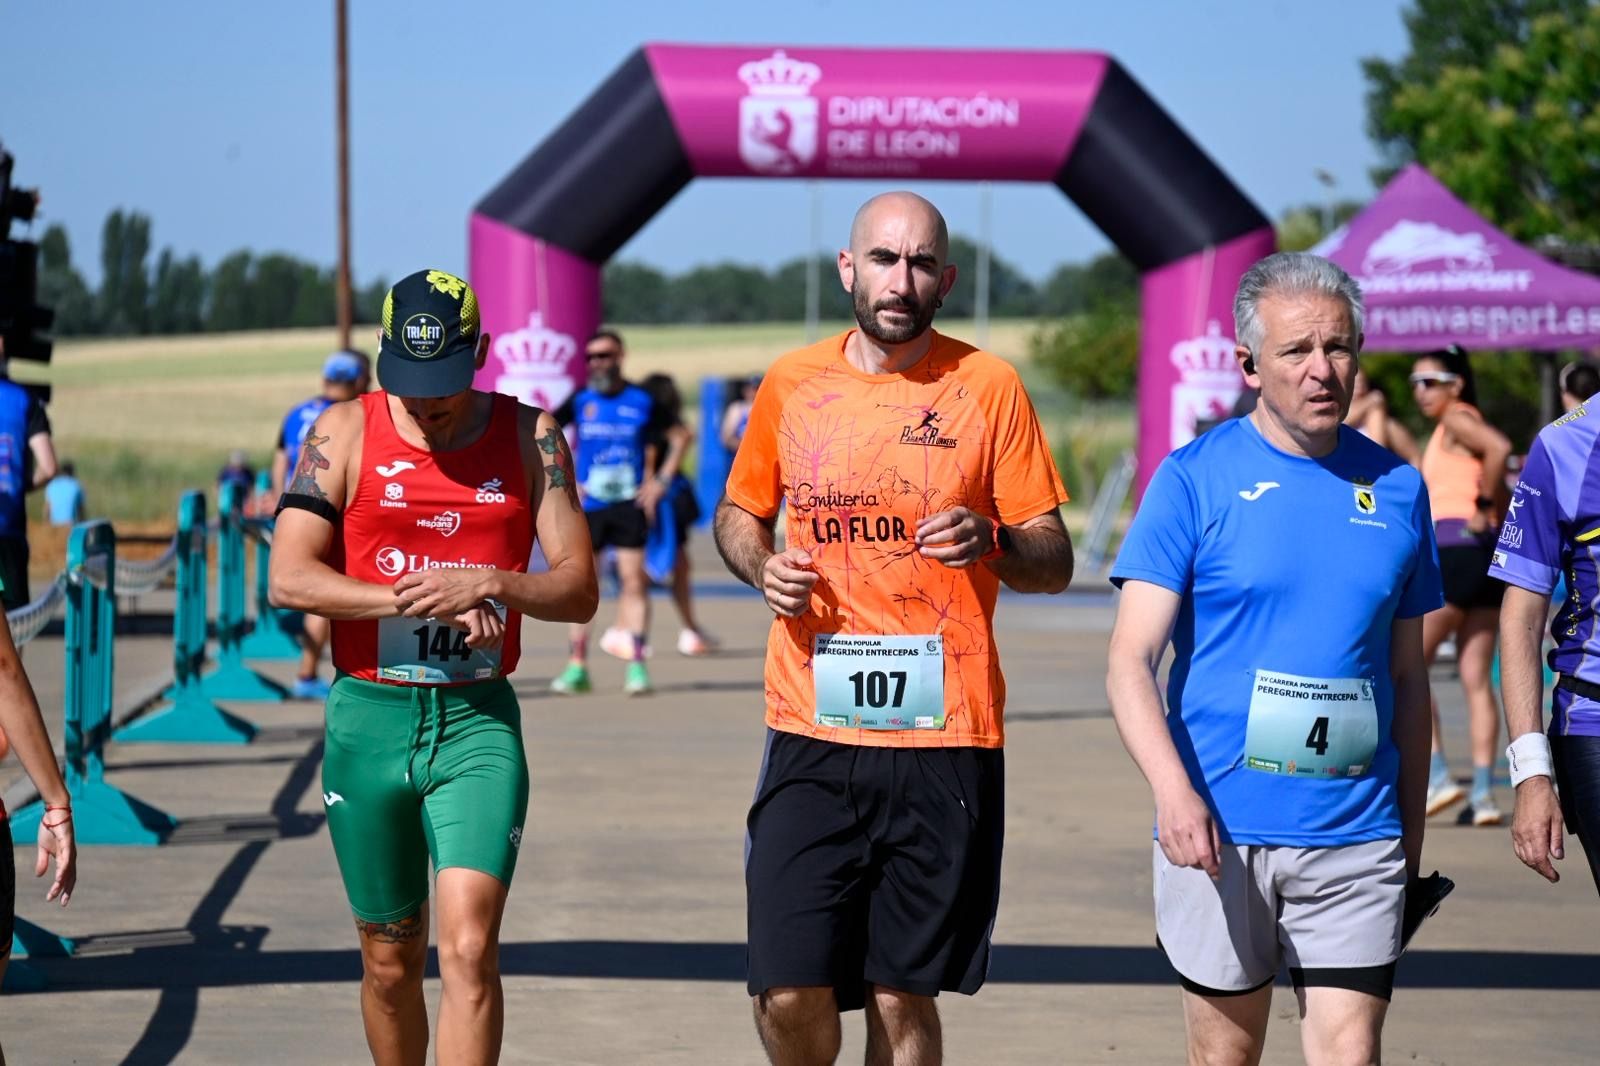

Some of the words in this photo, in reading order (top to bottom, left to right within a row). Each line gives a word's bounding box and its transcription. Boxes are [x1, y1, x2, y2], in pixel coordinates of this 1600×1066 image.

[828, 91, 1020, 127] DIPUTACIÓN
[828, 129, 870, 158] DE
[874, 124, 961, 158] LEÓN
[406, 325, 441, 340] TRI4FIT
[380, 500, 407, 508] Llanes
[416, 519, 453, 529] Hispana
[812, 517, 842, 544] LA
[850, 516, 908, 543] FLOR
[413, 625, 472, 661] 144
[817, 647, 863, 656] PEREGRINO
[848, 670, 907, 709] 107
[1258, 685, 1309, 699] PEREGRINO
[1311, 692, 1358, 701] ENTRECEPAS
[1269, 678, 1298, 687] CARRERA
[1305, 716, 1329, 756] 4
